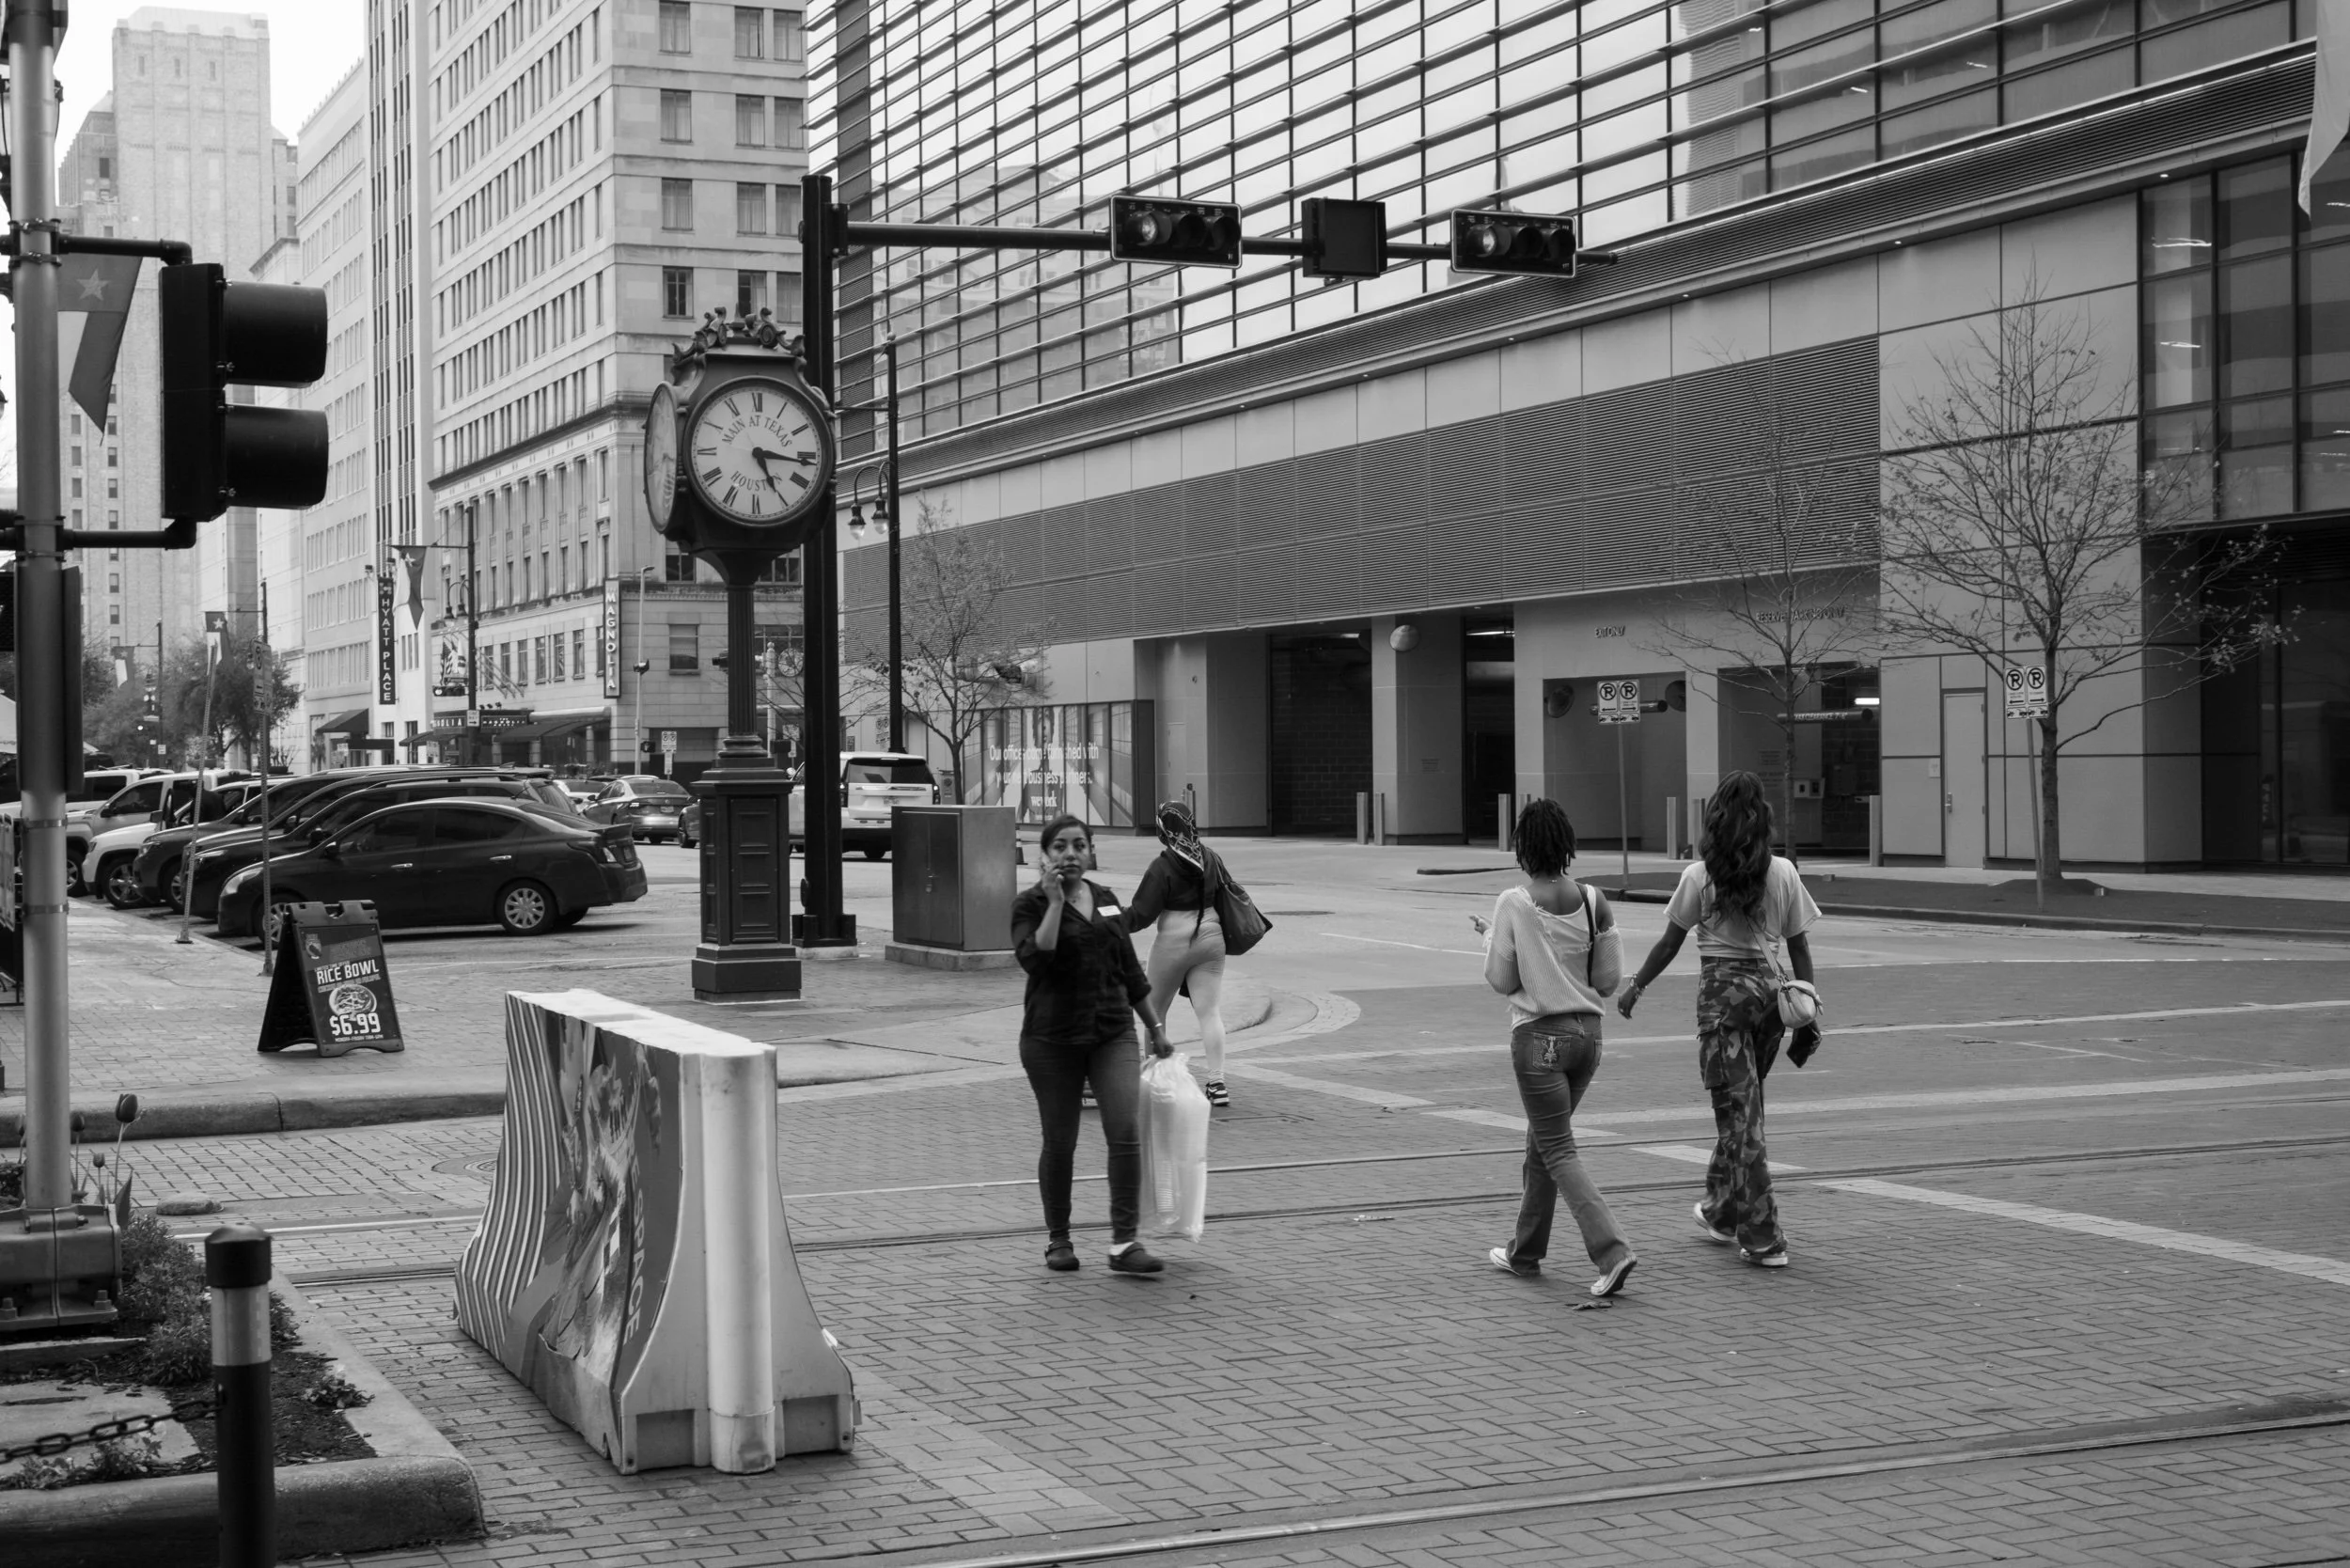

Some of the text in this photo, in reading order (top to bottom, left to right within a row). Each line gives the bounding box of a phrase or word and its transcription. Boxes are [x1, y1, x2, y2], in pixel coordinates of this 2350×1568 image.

[722, 415, 792, 447] MAIN AT TEXAS
[730, 470, 783, 492] HOUSTN
[1755, 609, 1788, 623] RESERVE
[382, 598, 392, 701] HYATT PLACE
[605, 592, 617, 689] MAGNOLIA
[1047, 742, 1082, 760] furnshed
[995, 771, 1011, 789] yur
[1059, 771, 1093, 790] prtner.
[316, 966, 342, 985] RICE
[344, 959, 380, 980] BOWL
[329, 1011, 382, 1036] $6.99
[623, 1187, 645, 1347] SPACE
